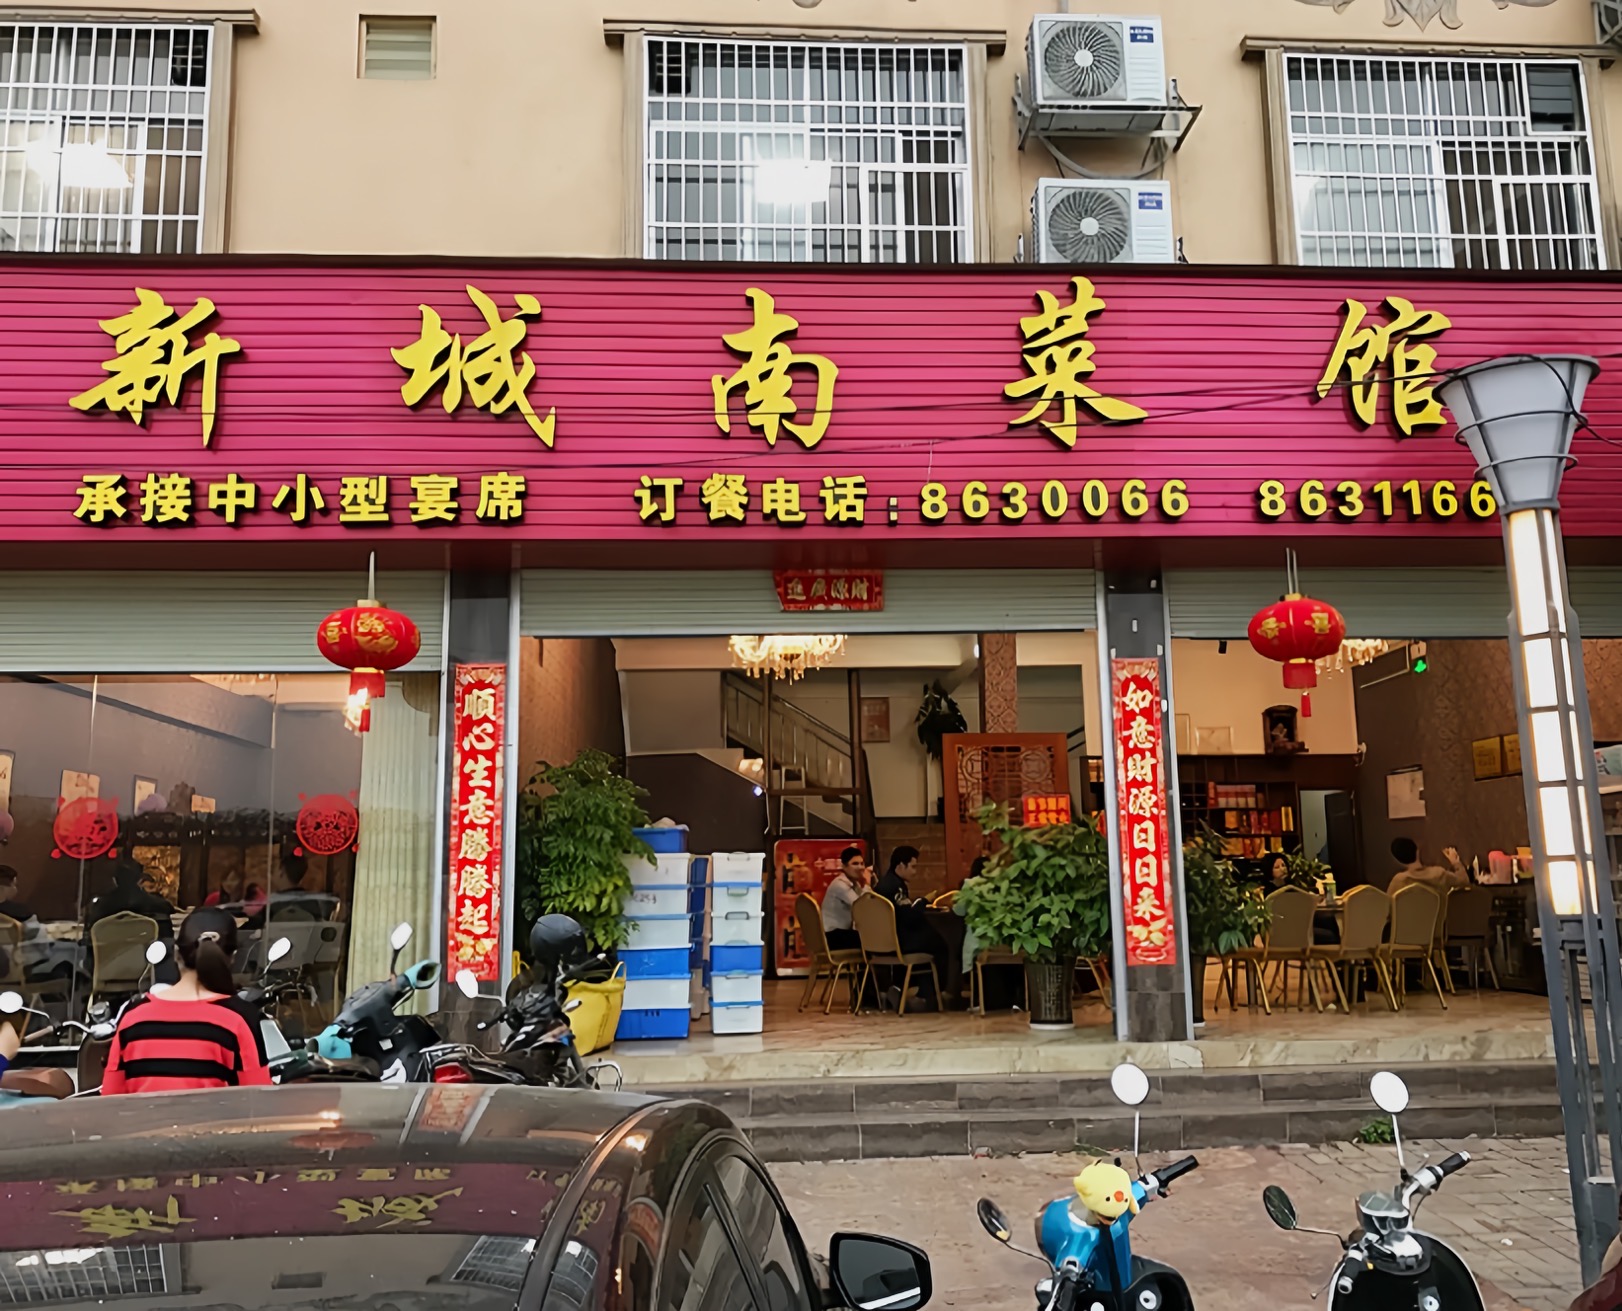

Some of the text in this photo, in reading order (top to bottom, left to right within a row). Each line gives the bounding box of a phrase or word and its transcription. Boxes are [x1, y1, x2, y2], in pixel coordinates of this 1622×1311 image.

[69, 277, 1452, 448] 新城南菜馆
[74, 472, 526, 523] 承接中小型宴席
[1259, 480, 1496, 517] 8631166
